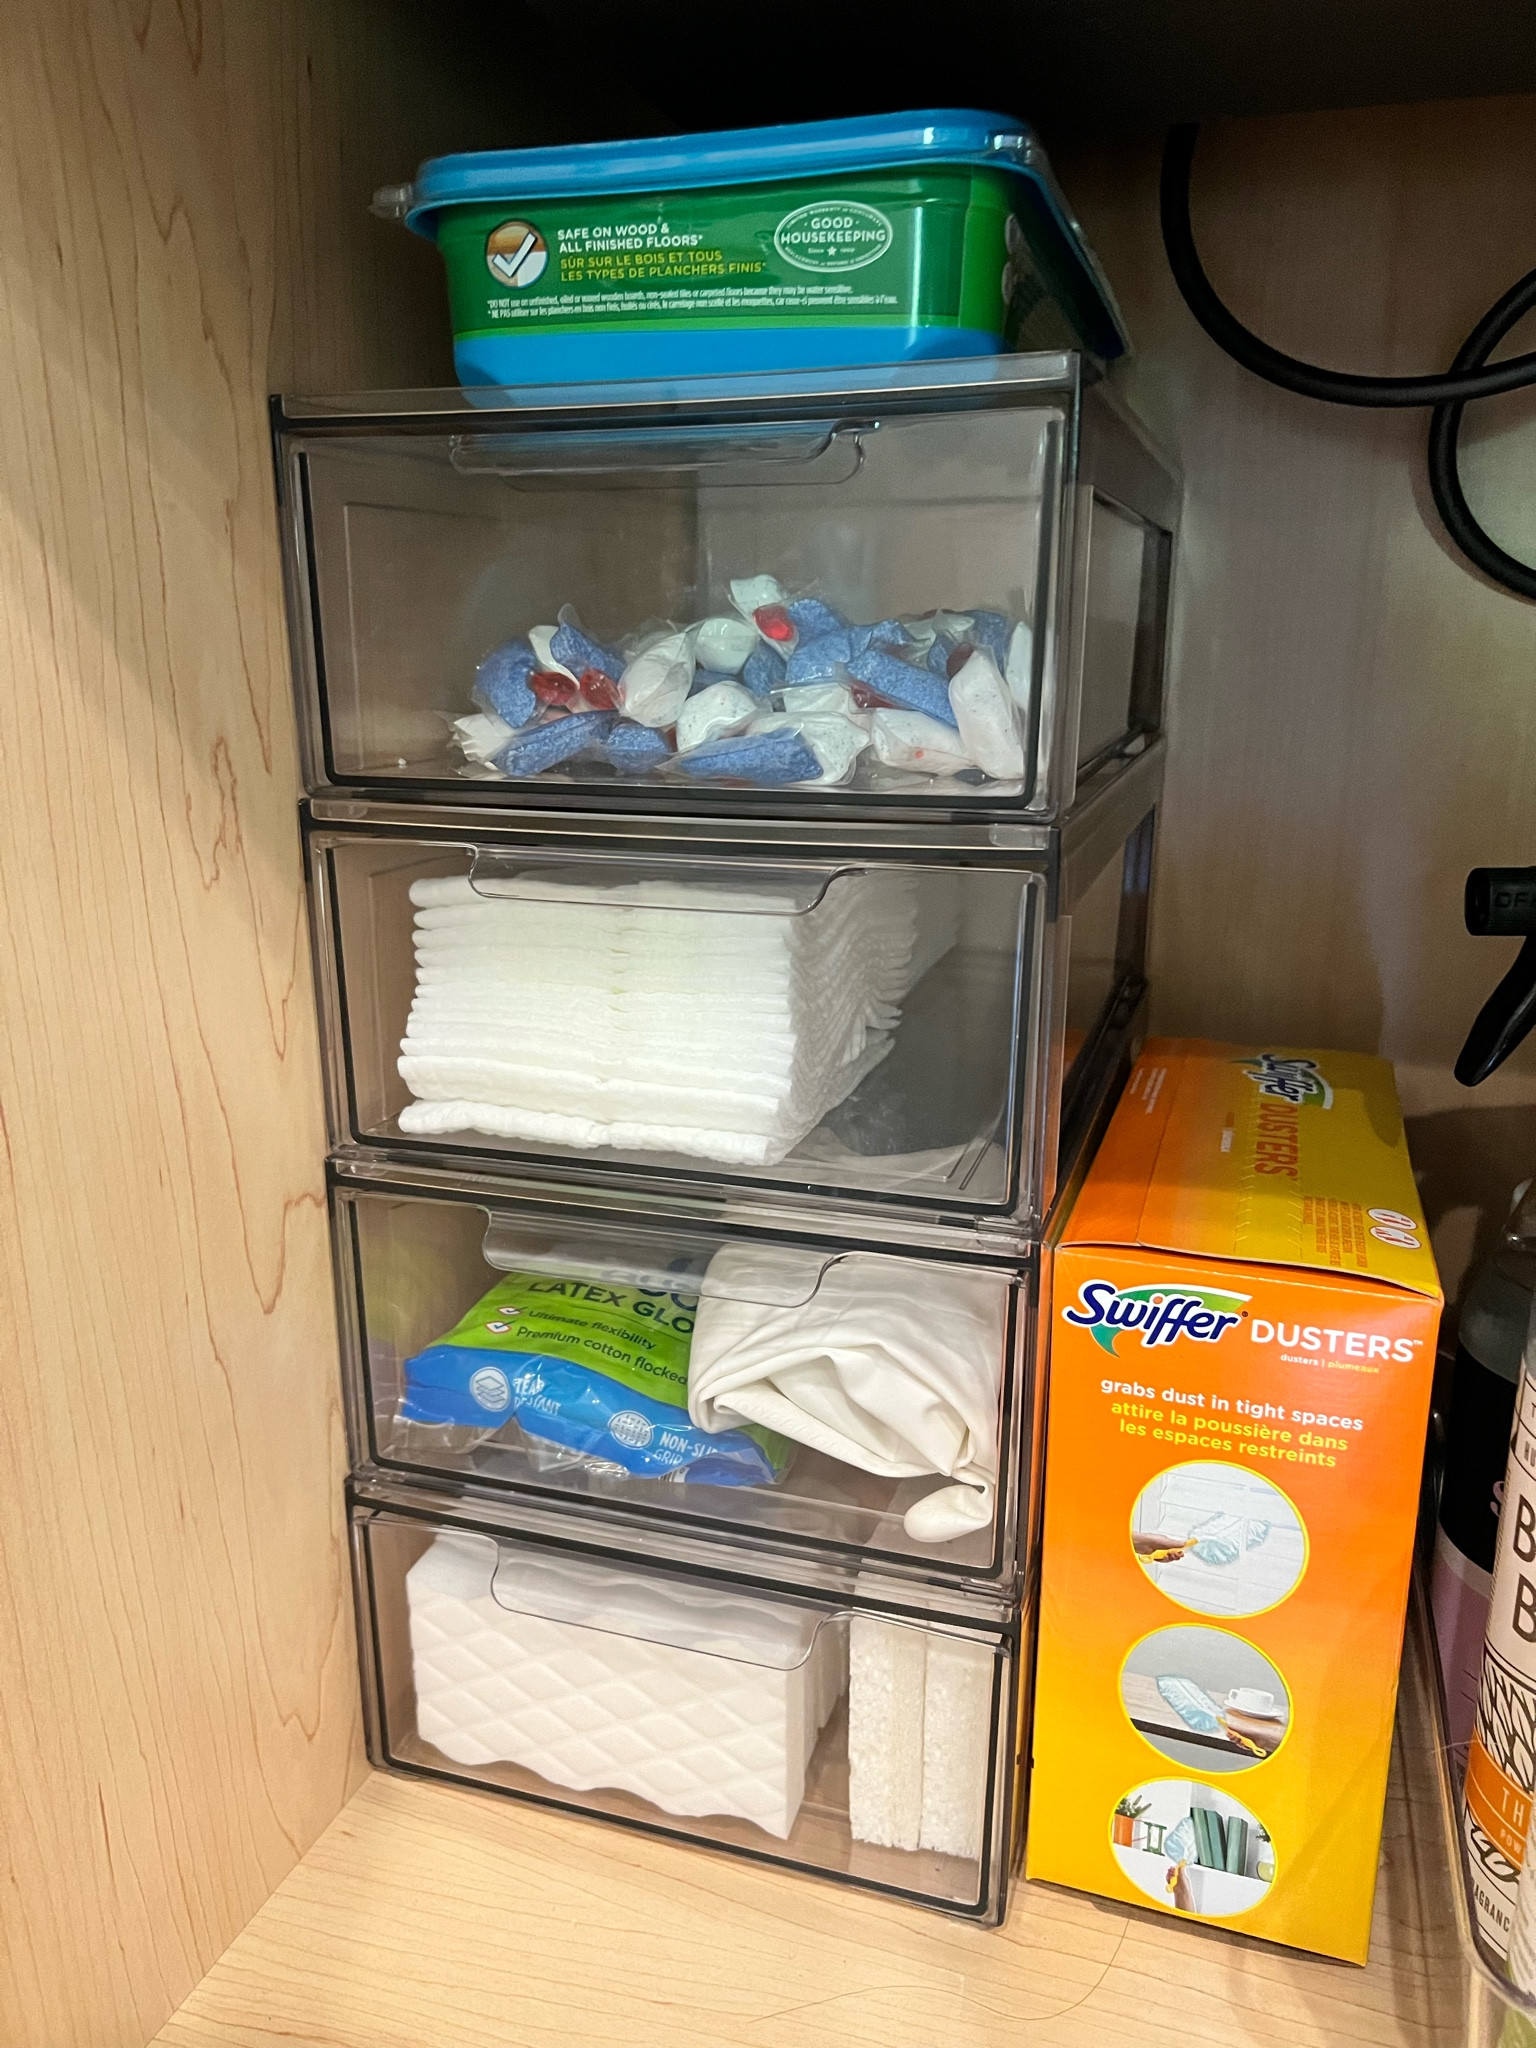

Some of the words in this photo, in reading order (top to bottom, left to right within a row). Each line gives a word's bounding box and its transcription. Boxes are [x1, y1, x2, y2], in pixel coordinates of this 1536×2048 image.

[557, 227, 589, 241] SAFE
[592, 225, 613, 239] ON
[615, 224, 658, 237] WOOD
[660, 223, 670, 234] &
[810, 216, 854, 230] GOOD
[559, 241, 583, 254] ALL
[585, 237, 643, 252] FINISHED
[780, 230, 886, 245] HOUSEKEEPING
[560, 254, 585, 270] SÛR
[588, 256, 613, 269] SUR
[616, 254, 632, 267] LE
[635, 252, 665, 265] BOIS
[668, 251, 685, 263] ET
[688, 250, 723, 263] TOUS
[561, 270, 583, 282] LES
[586, 267, 625, 281] TYPES
[628, 267, 645, 279] DE
[649, 263, 725, 278] PLANCHERS
[1246, 1053, 1319, 1103] Swiffer
[527, 1281, 628, 1308] LATEX
[1066, 1283, 1239, 1346] Swiffer
[528, 1309, 589, 1328] Ultimate
[590, 1321, 657, 1351] flexibility
[516, 1325, 581, 1346] Premium
[583, 1338, 632, 1364] cotton
[1280, 1353, 1319, 1366] dusters
[1327, 1360, 1379, 1374] plumeaux
[1100, 1379, 1156, 1399] grabs
[1161, 1387, 1206, 1408] dust
[1211, 1394, 1230, 1412] in
[1236, 1399, 1286, 1420] tight
[1291, 1409, 1364, 1432] spaces
[1111, 1402, 1164, 1422] attire
[1170, 1409, 1188, 1426] la
[1193, 1416, 1292, 1443] poussière
[1298, 1431, 1349, 1451] dans
[1120, 1418, 1147, 1437] les
[1152, 1427, 1233, 1452] espaces
[1239, 1441, 1337, 1468] restreints
